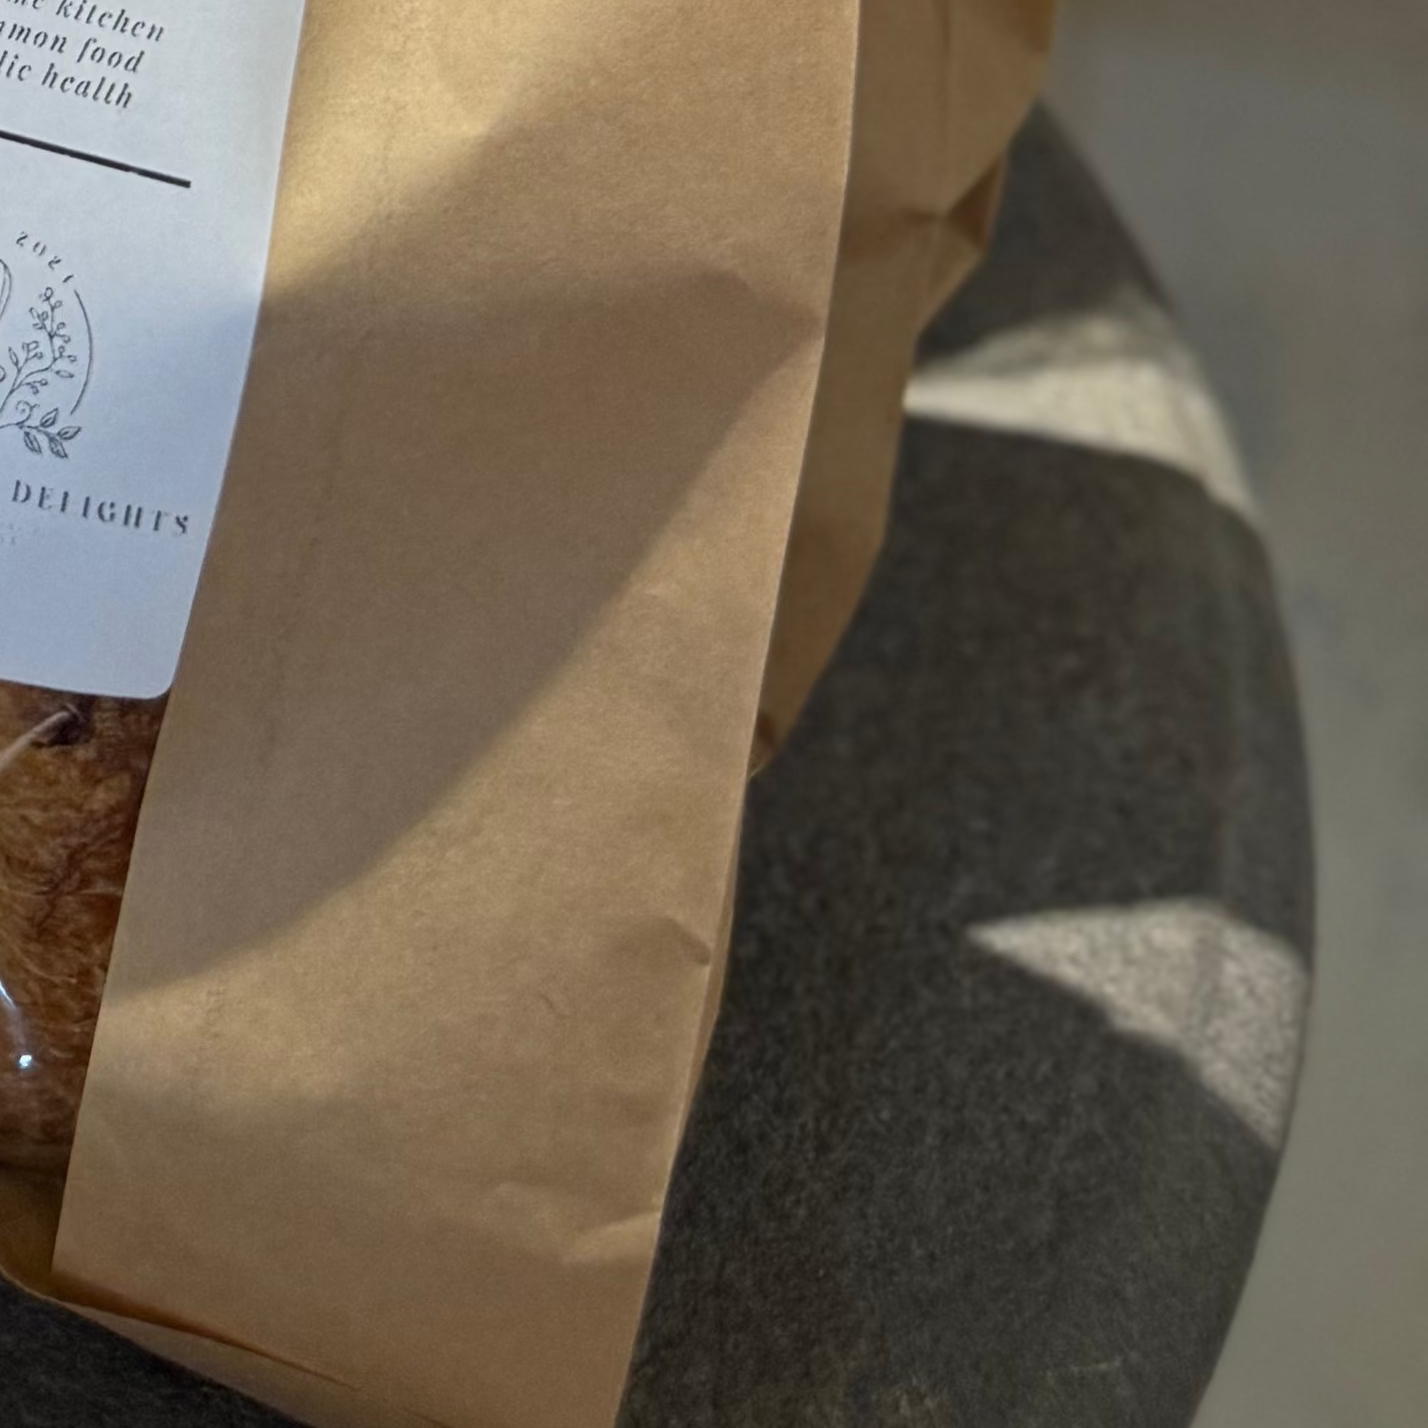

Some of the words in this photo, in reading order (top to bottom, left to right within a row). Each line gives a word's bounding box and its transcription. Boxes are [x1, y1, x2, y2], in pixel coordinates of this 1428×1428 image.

[76, 36, 146, 75] food
[41, 62, 134, 109] health
[11, 479, 189, 535] DELIGHTS
